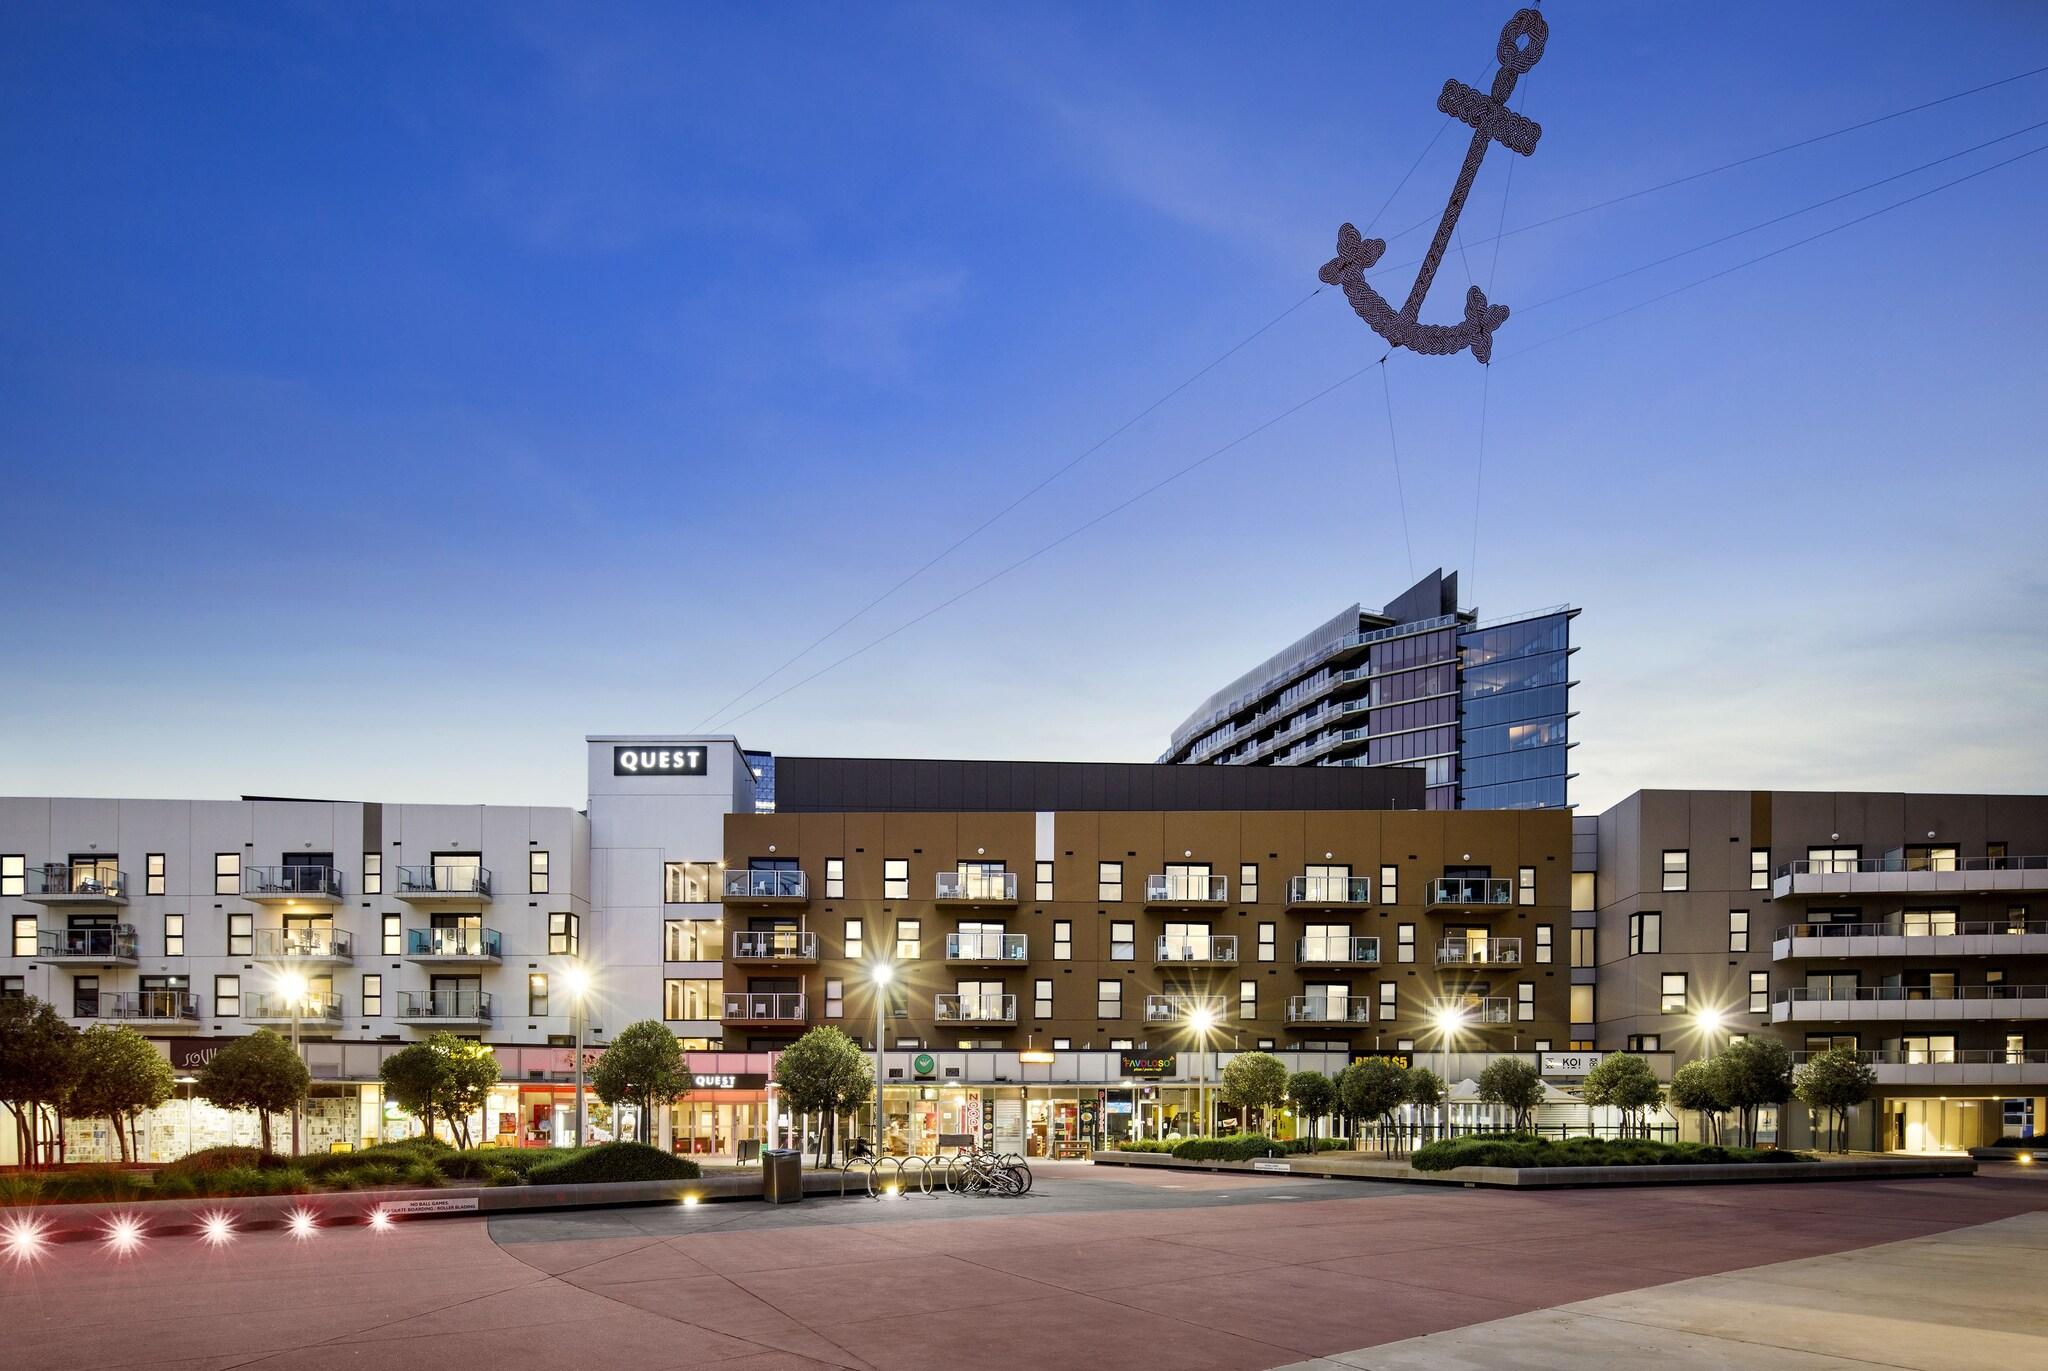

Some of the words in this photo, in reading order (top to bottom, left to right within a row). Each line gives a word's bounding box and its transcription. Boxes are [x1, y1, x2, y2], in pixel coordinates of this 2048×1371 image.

[620, 751, 700, 771] QUEST
[1123, 1059, 1170, 1067] FAVOLOSO
[1392, 1056, 1408, 1070] $5
[1563, 1058, 1581, 1067] KOI
[695, 1075, 736, 1087] QUEST
